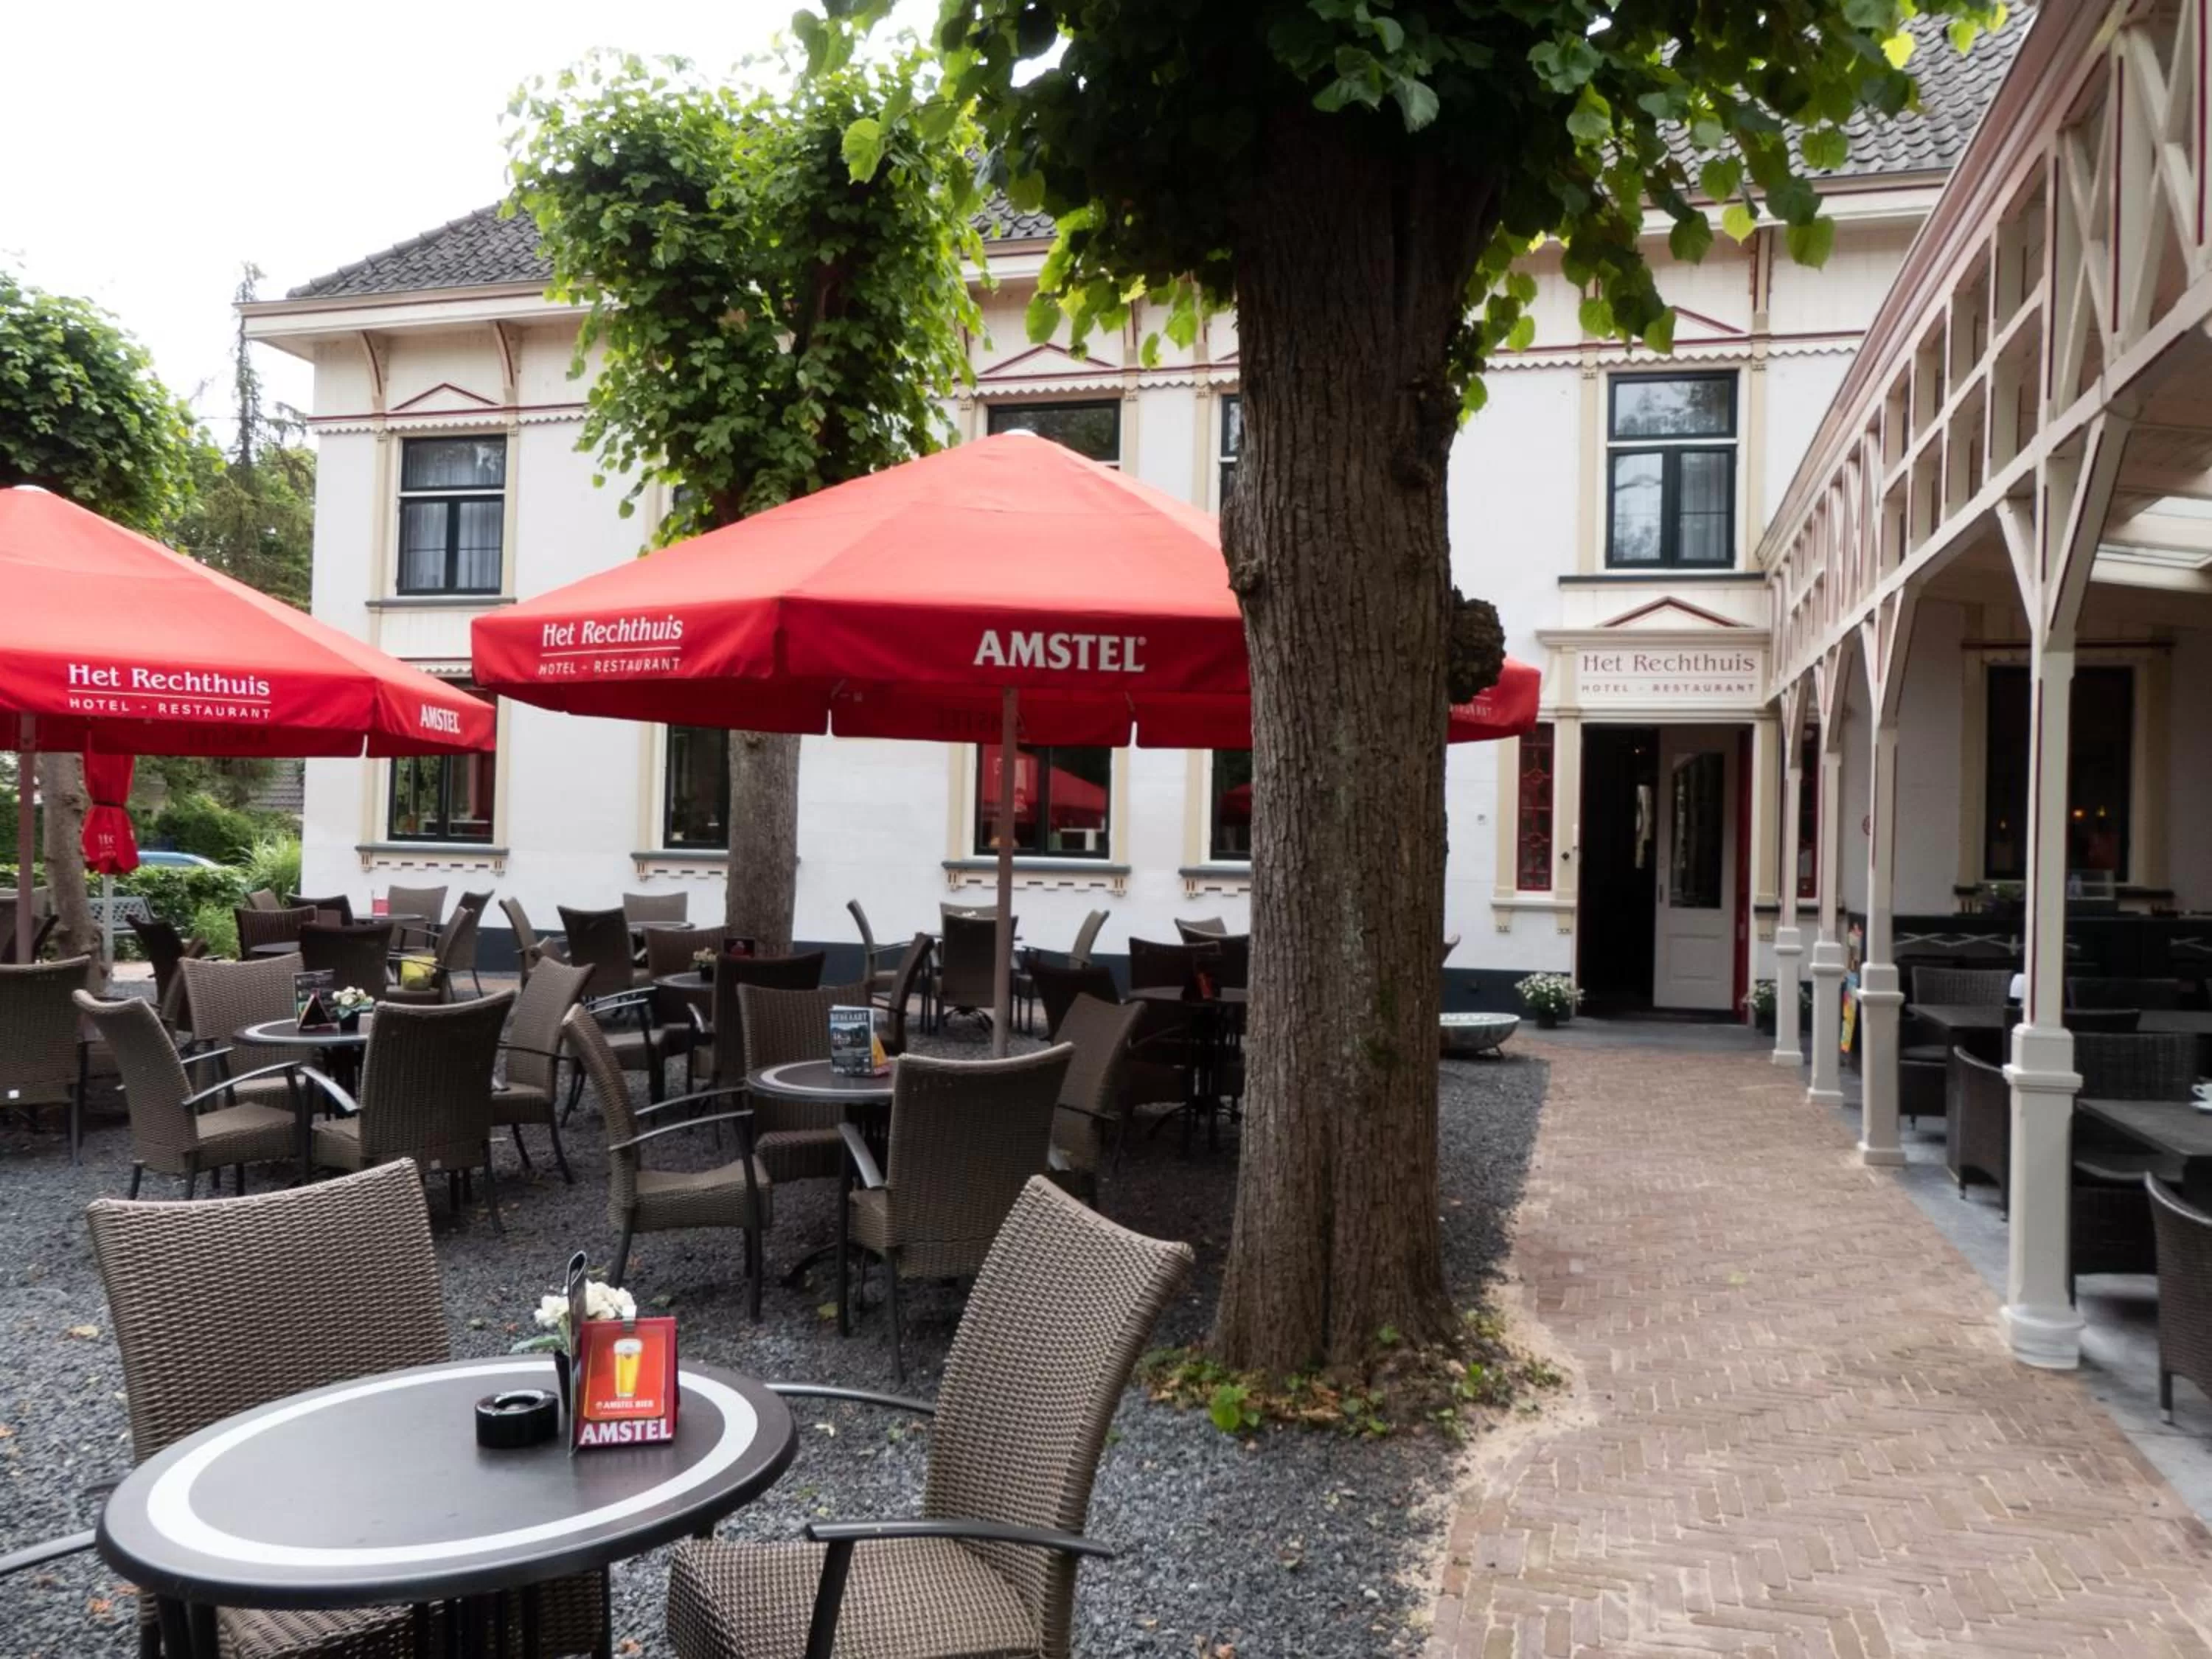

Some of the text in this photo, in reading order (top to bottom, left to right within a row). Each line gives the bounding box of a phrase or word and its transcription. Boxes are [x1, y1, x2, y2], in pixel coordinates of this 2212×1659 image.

[541, 613, 684, 647] Het Rechthuis
[538, 661, 577, 676] HOTEL
[594, 657, 681, 674] RESTAURANT
[1583, 653, 1756, 672] Het Rechthuis
[68, 663, 271, 696] Het Rechthuis
[1581, 684, 1629, 692] HOTEL
[1652, 683, 1755, 693] RESTAURANT
[69, 697, 130, 712] HOTEL
[157, 702, 271, 720] RESTAURANT
[420, 703, 461, 734] AMSTEL
[579, 1417, 672, 1445] AMSTEL
